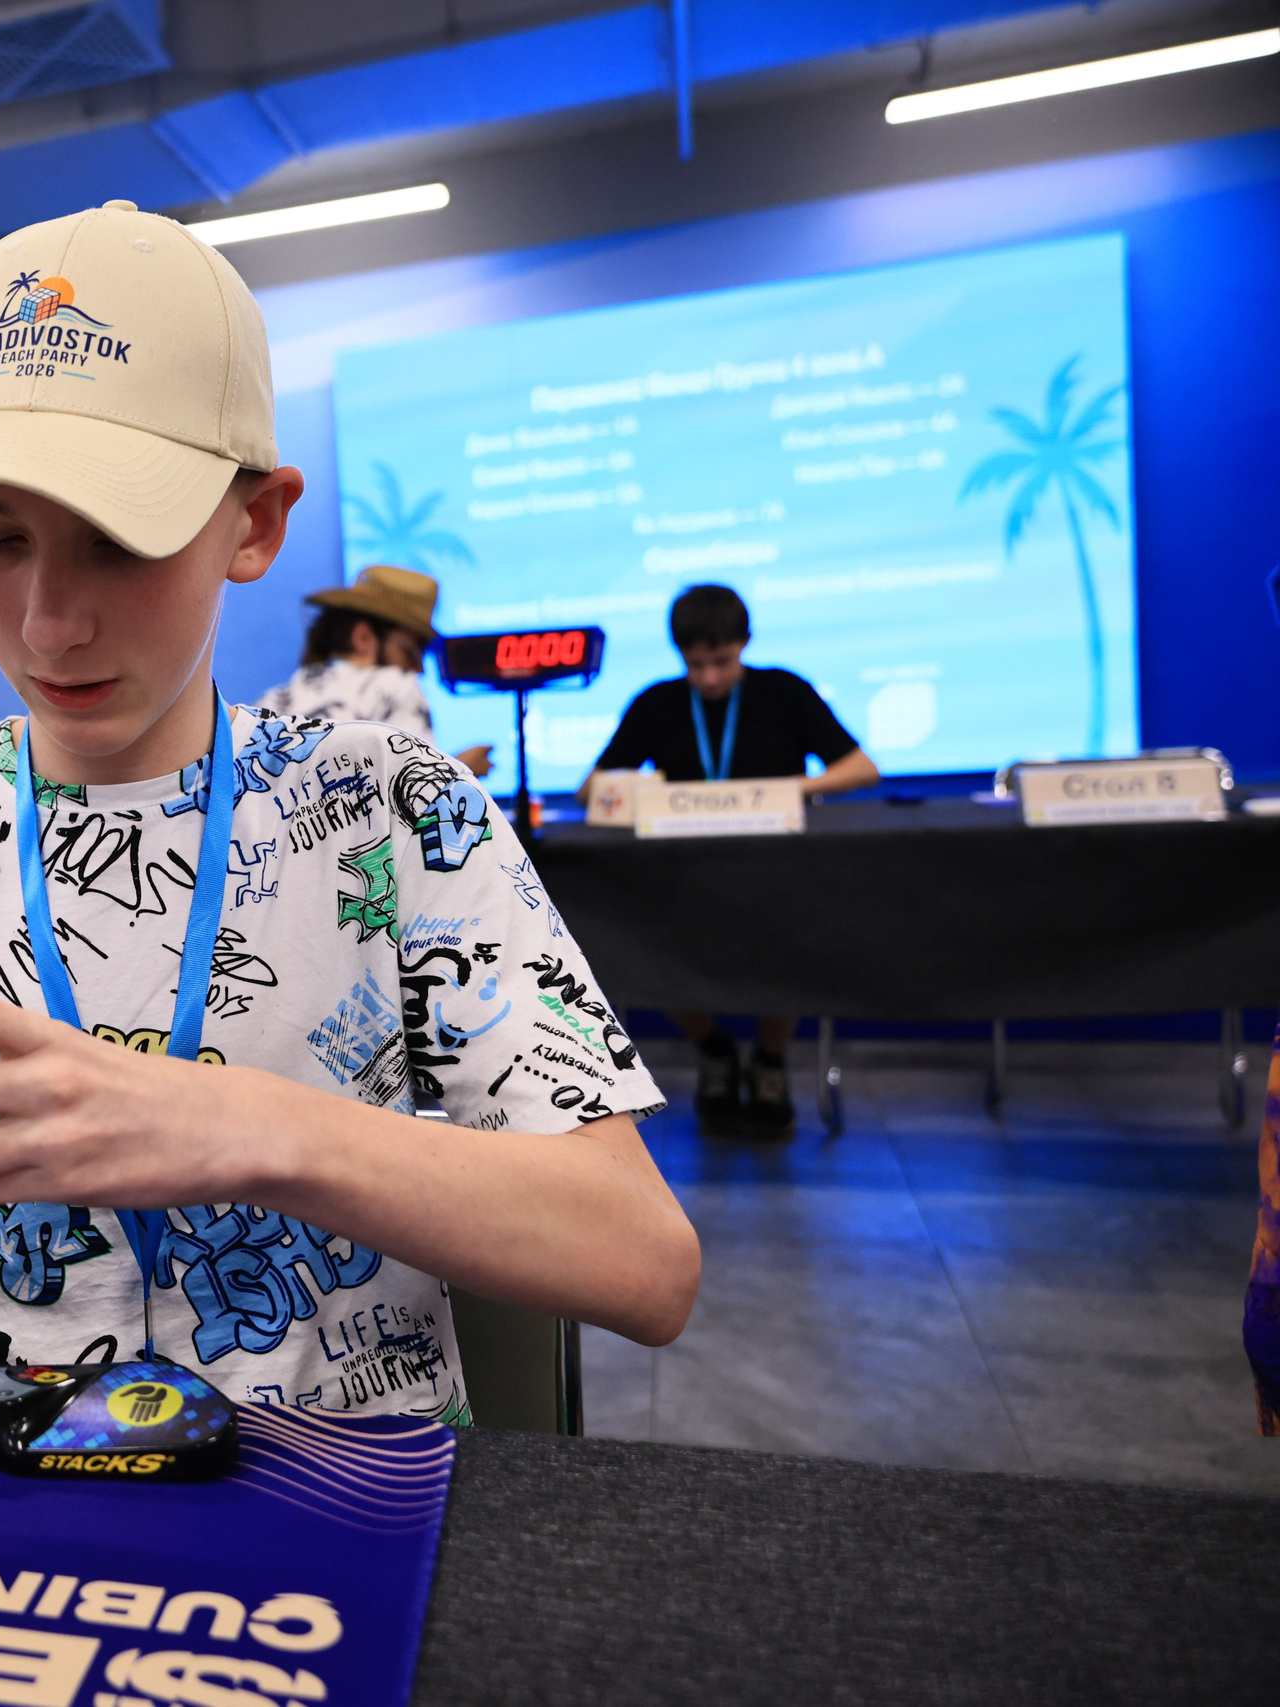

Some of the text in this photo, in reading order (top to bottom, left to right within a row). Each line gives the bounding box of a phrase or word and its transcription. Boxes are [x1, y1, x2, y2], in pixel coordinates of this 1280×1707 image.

[40, 349, 88, 367] PARTY
[15, 364, 55, 377] 2026
[333, 754, 351, 771] IS
[354, 755, 374, 776] AN
[668, 787, 763, 813] Стол 7
[434, 932, 462, 947] MOOD
[532, 1043, 616, 1088] CONFIDENTLY
[318, 1303, 436, 1362] LIFE IS AN
[339, 1340, 448, 1409] JOURNEY
[39, 1453, 167, 1474] STACKS
